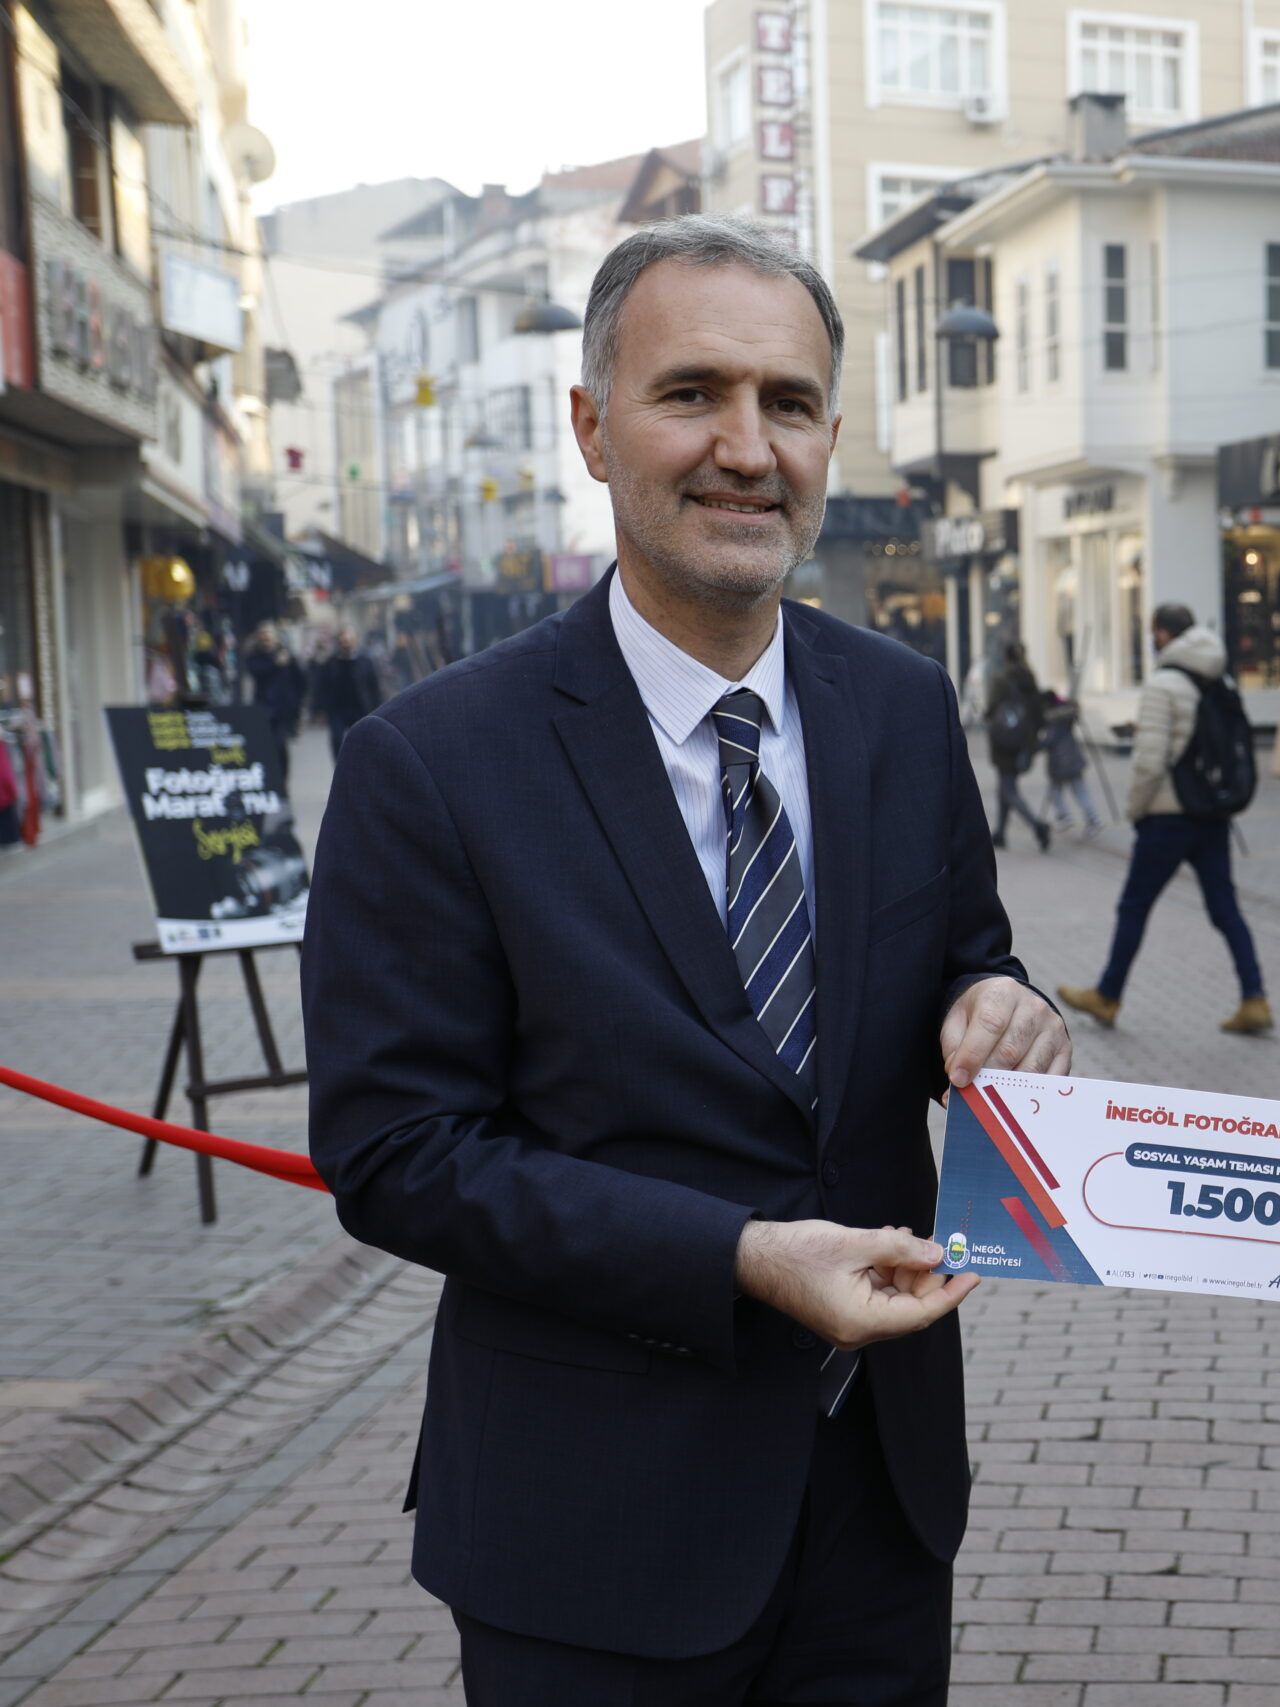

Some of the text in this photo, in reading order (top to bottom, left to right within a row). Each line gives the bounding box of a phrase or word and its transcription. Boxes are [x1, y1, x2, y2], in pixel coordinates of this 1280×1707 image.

[145, 761, 265, 797] Fotoğraf
[1105, 1100, 1179, 1127] İNEGÖL
[1133, 1150, 1181, 1165] SOSYAL
[1183, 1155, 1227, 1170] YAŞAM
[1229, 1160, 1274, 1175] TEMASI
[971, 1242, 1006, 1255] İNEGÖL
[970, 1255, 1022, 1267] BELEDİYESİ
[1164, 1274, 1193, 1283] inegolbld
[1209, 1278, 1263, 1289] www.inegol.bel.tr
